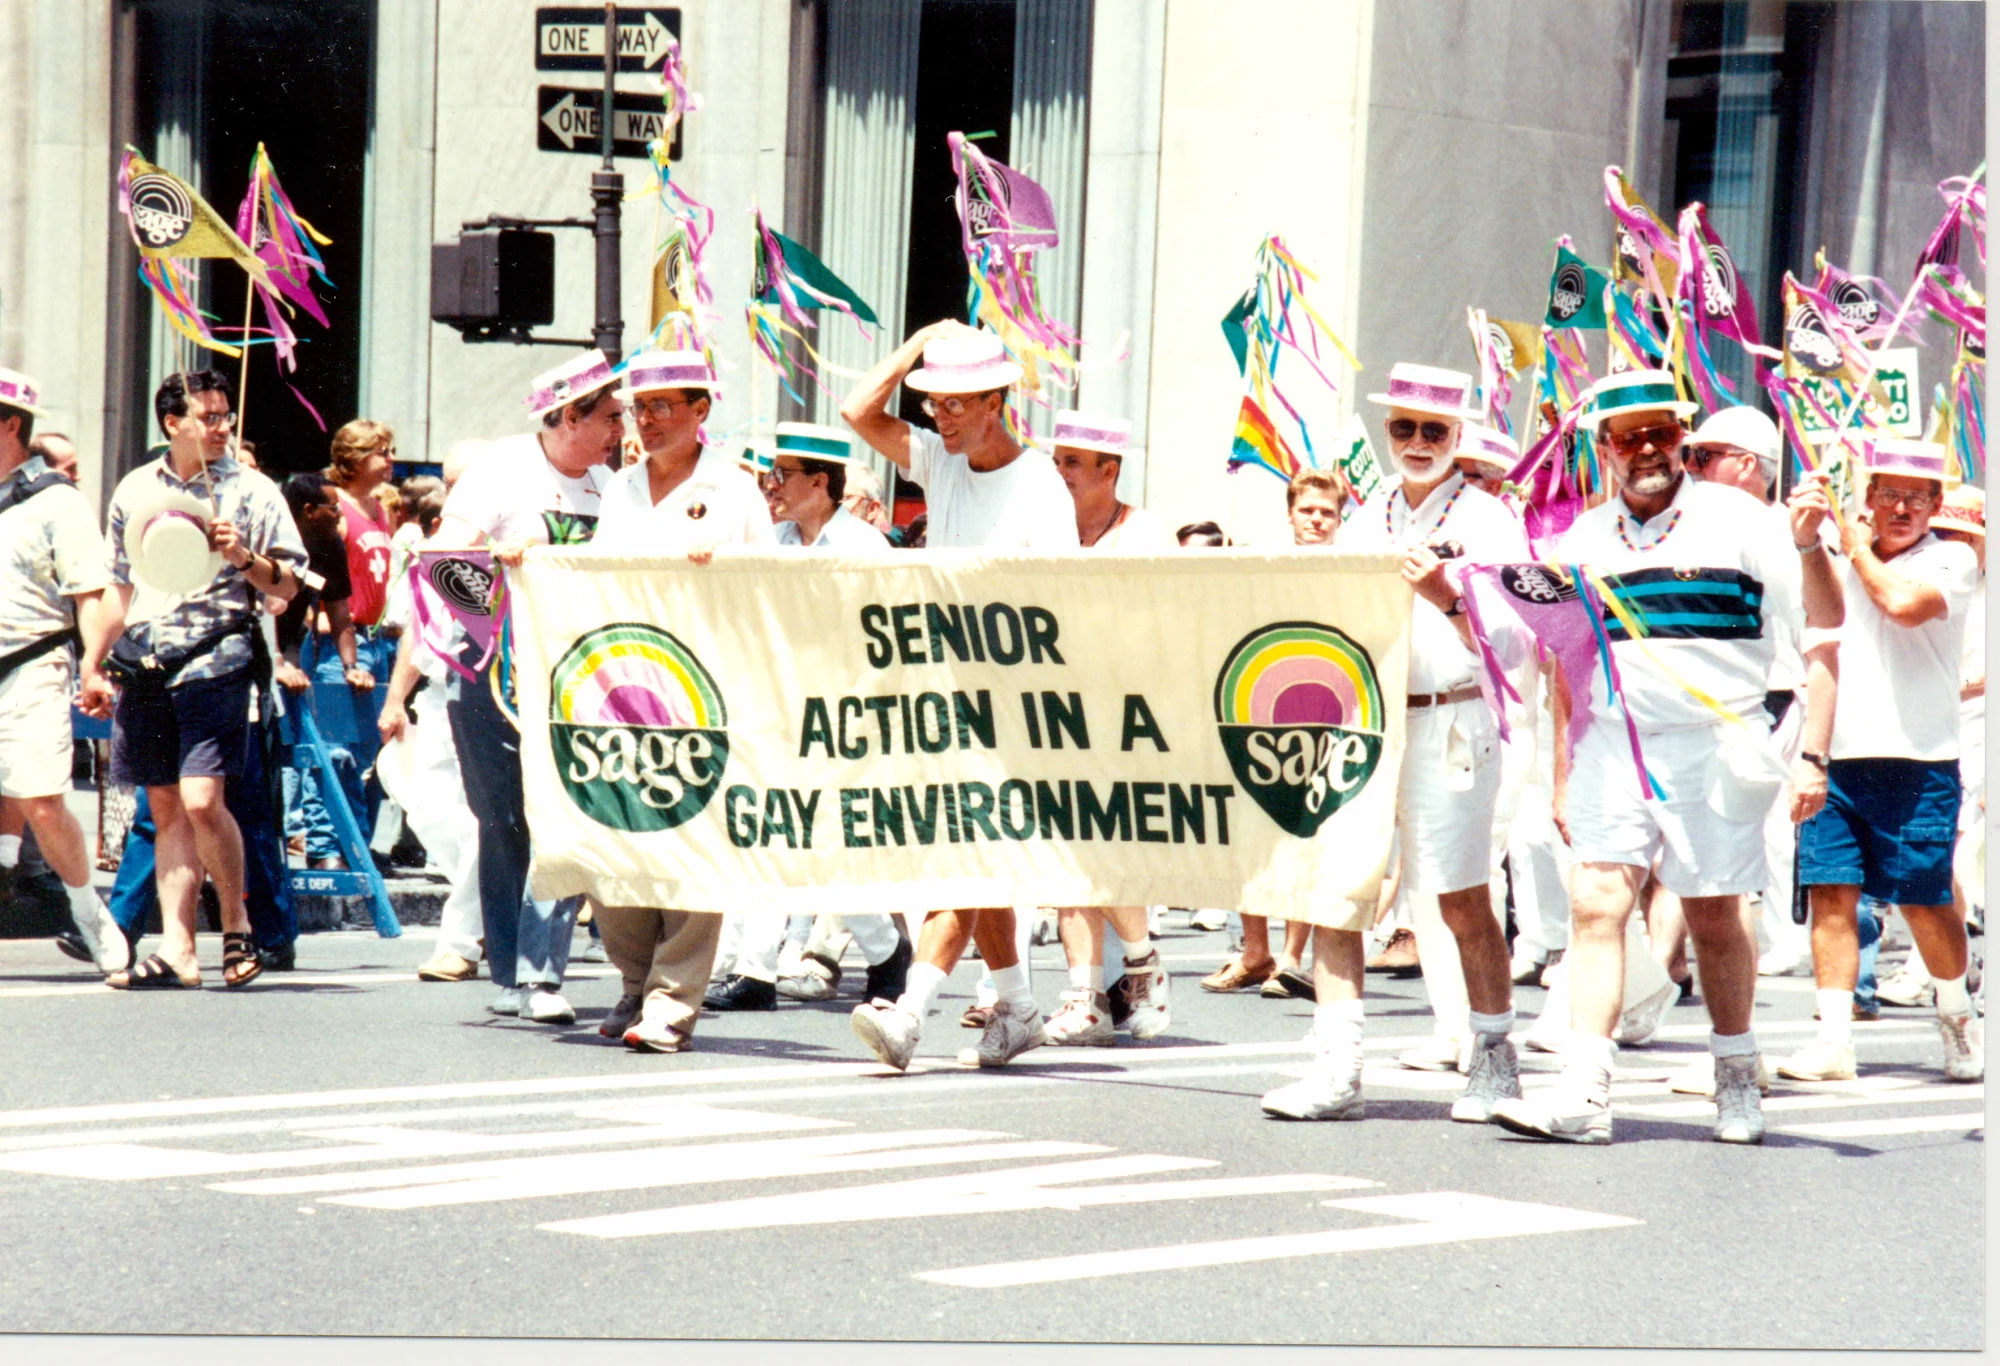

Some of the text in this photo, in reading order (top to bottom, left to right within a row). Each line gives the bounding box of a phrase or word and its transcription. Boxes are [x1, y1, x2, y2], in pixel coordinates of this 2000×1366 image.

[548, 28, 661, 53] ONE WAY
[559, 108, 600, 136] ONE
[860, 602, 1067, 669] SENIOR
[799, 689, 1171, 760] ACTION IN A
[569, 728, 714, 809] sage
[725, 778, 1236, 849] GAY ENVIRONMENT
